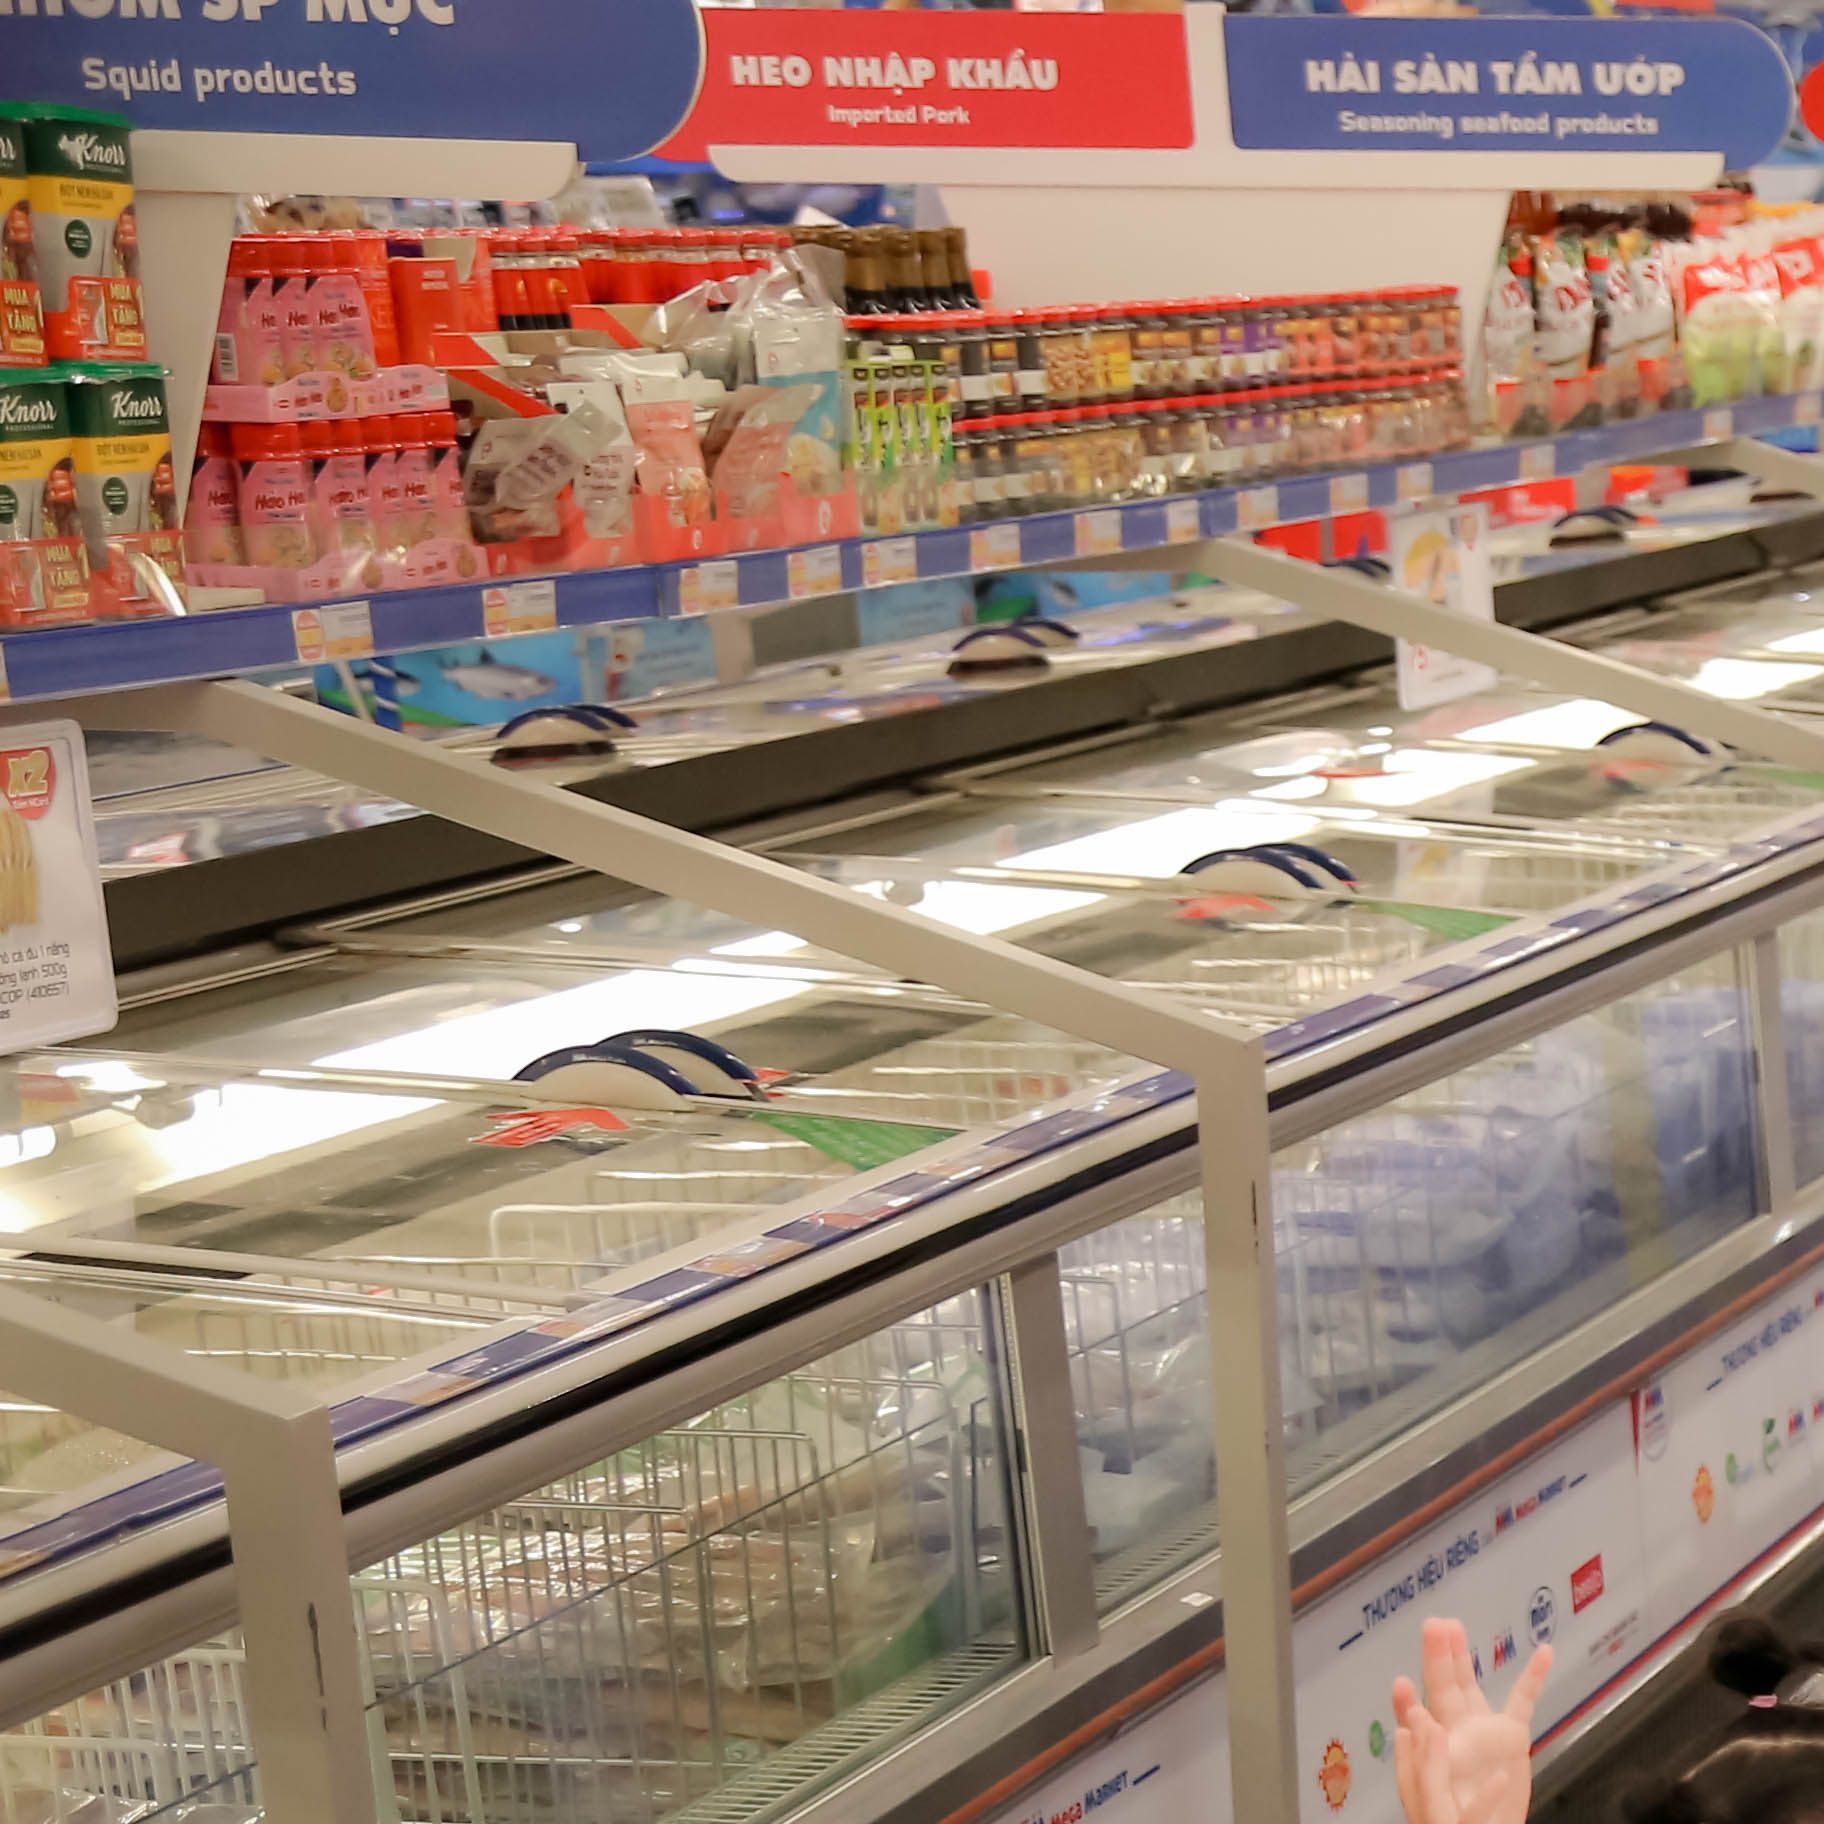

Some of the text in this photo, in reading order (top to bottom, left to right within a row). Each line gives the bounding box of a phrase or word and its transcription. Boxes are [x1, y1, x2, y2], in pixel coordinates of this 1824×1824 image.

[81, 57, 358, 103] Squid products
[730, 48, 1060, 96] HEO NHẬP KHẨU
[828, 104, 970, 129] Imported Pork
[1339, 111, 1659, 140] Seasoning seafood products
[0, 394, 58, 424] Knorr
[111, 390, 164, 419] Knorr
